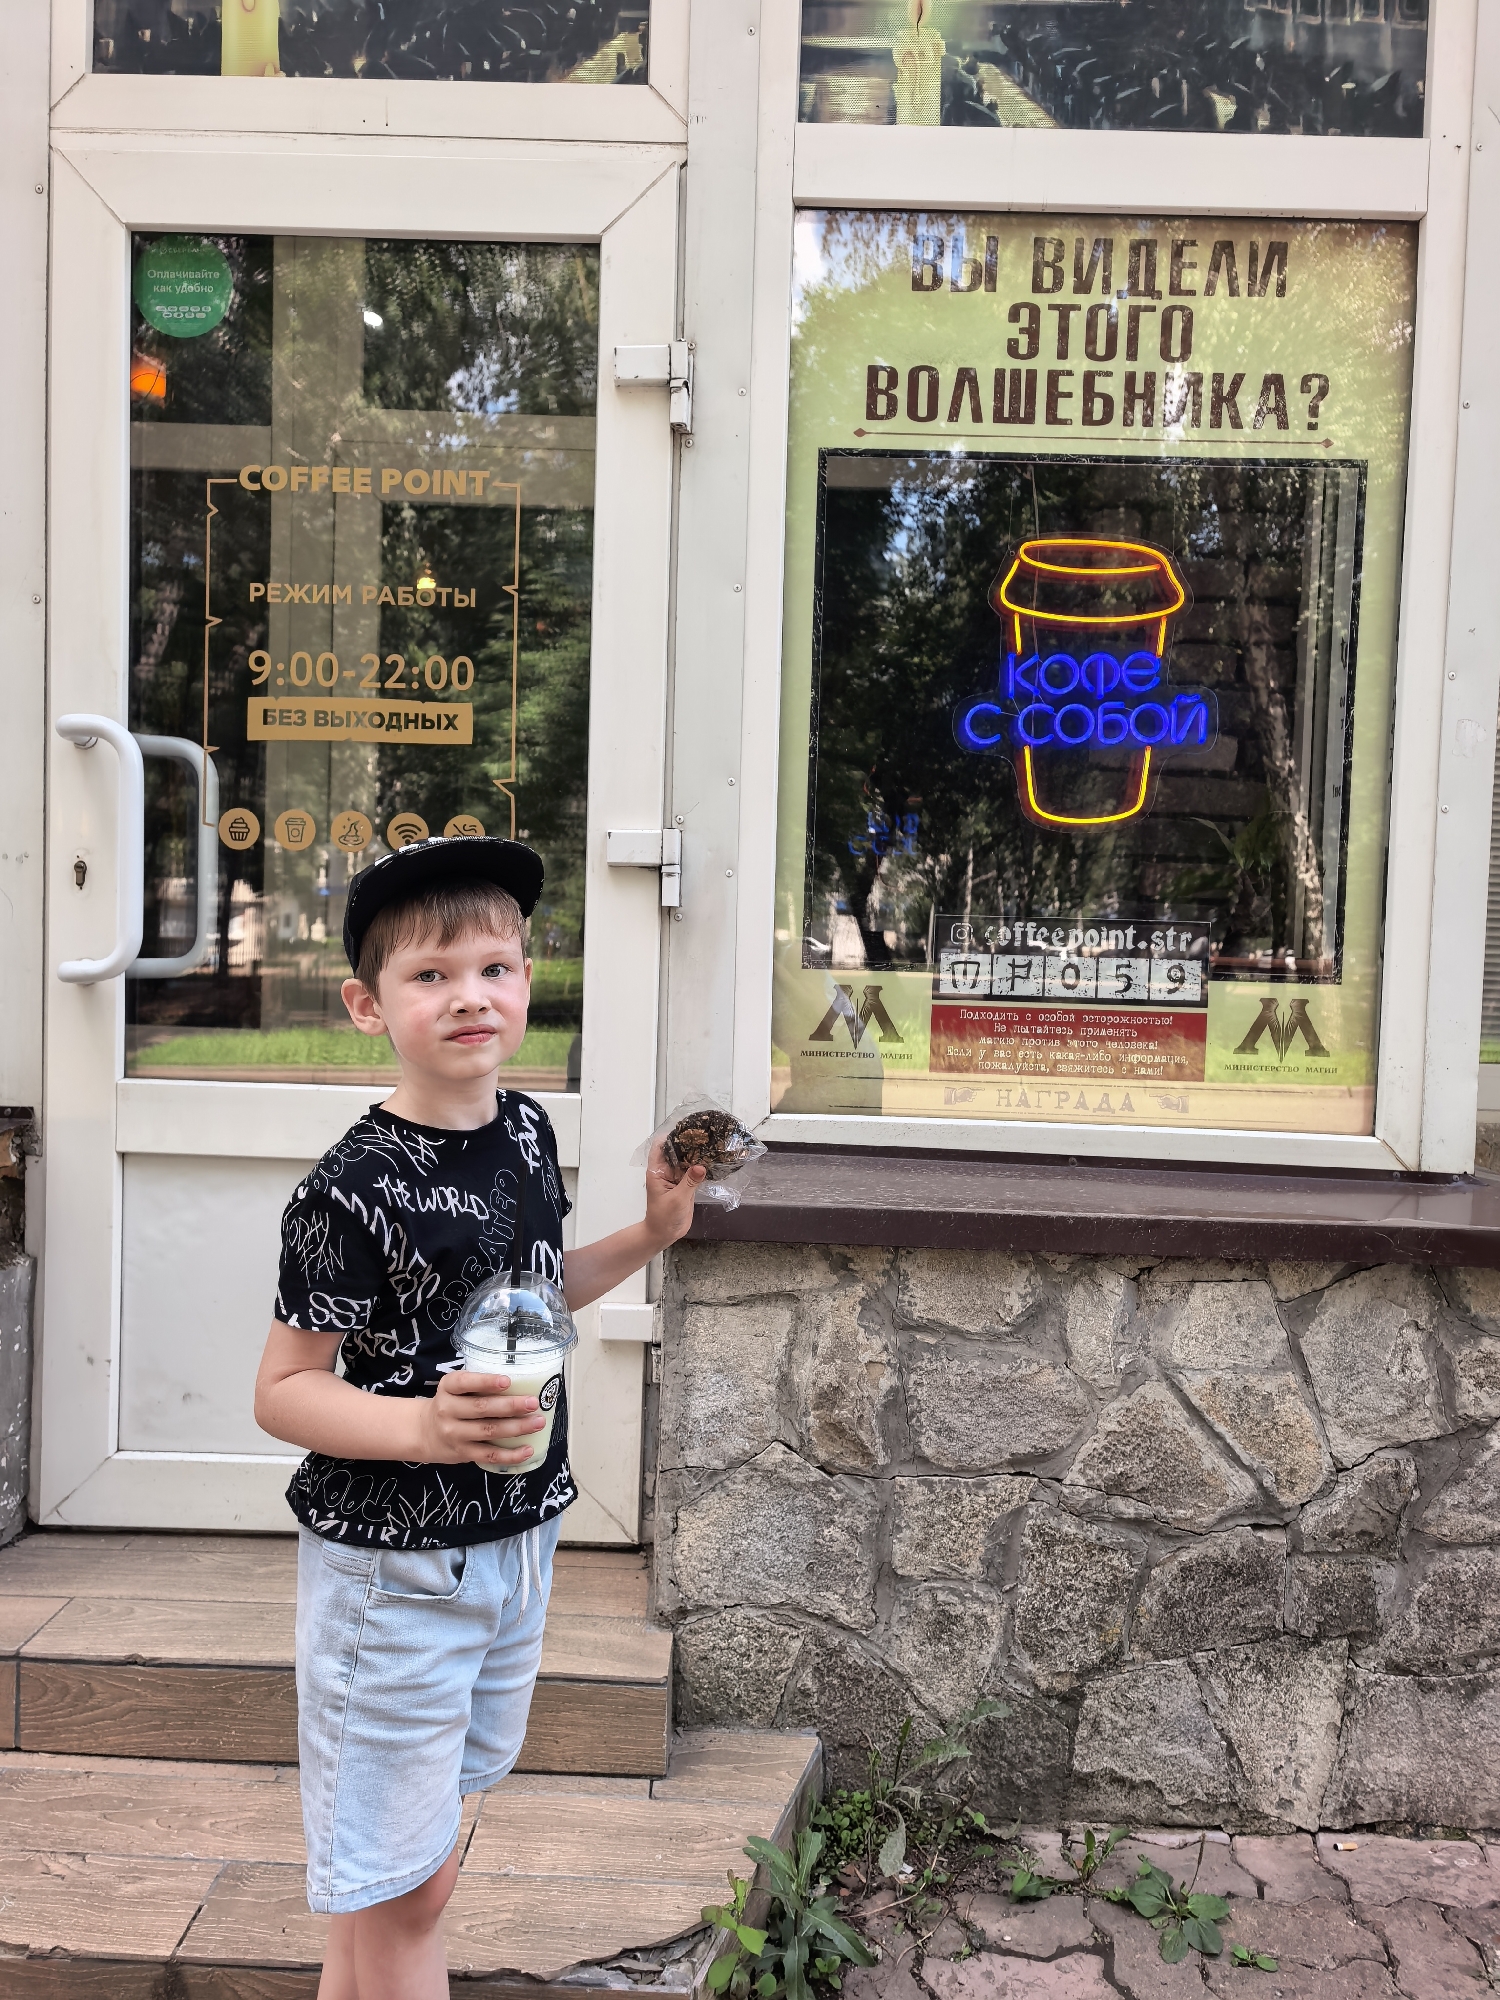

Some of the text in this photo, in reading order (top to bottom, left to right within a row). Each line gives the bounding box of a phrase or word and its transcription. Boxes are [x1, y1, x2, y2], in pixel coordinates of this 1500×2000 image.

[147, 268, 220, 280] Оплачивайте
[911, 235, 1289, 300] ВЫ ВИДЕЛИ
[153, 282, 214, 295] как удобно
[1006, 301, 1194, 364] ЭТОГО
[865, 364, 1330, 431] ВОЛШЕБНИКА?
[238, 464, 491, 496] COFFEE POINT
[249, 582, 476, 608] РЕЖИМ РАБОТЫ
[248, 650, 474, 690] 9:00-22:00
[262, 708, 459, 733] БЕЗ ВЫХОДНЫХ
[960, 1008, 1019, 1021] Подходить
[1038, 1010, 1075, 1022] особой
[1082, 1014, 1173, 1026] осторожностью!
[994, 1022, 1138, 1037] Не пытайтесь применять
[979, 1036, 1158, 1050] магию против этого человека!
[800, 1050, 913, 1060] МИНИСТЕРСТВО МАГИИ
[947, 1045, 1189, 1065] Если у вас есть какая-либо информация,
[978, 1061, 1164, 1076] пожалуйста, свяжитесь с нами!
[1223, 1063, 1338, 1074] МИНИСТЕРСТВО МАГИИ
[995, 1087, 1136, 1115] НАГРАДА
[372, 1173, 490, 1219] THE WORLD
